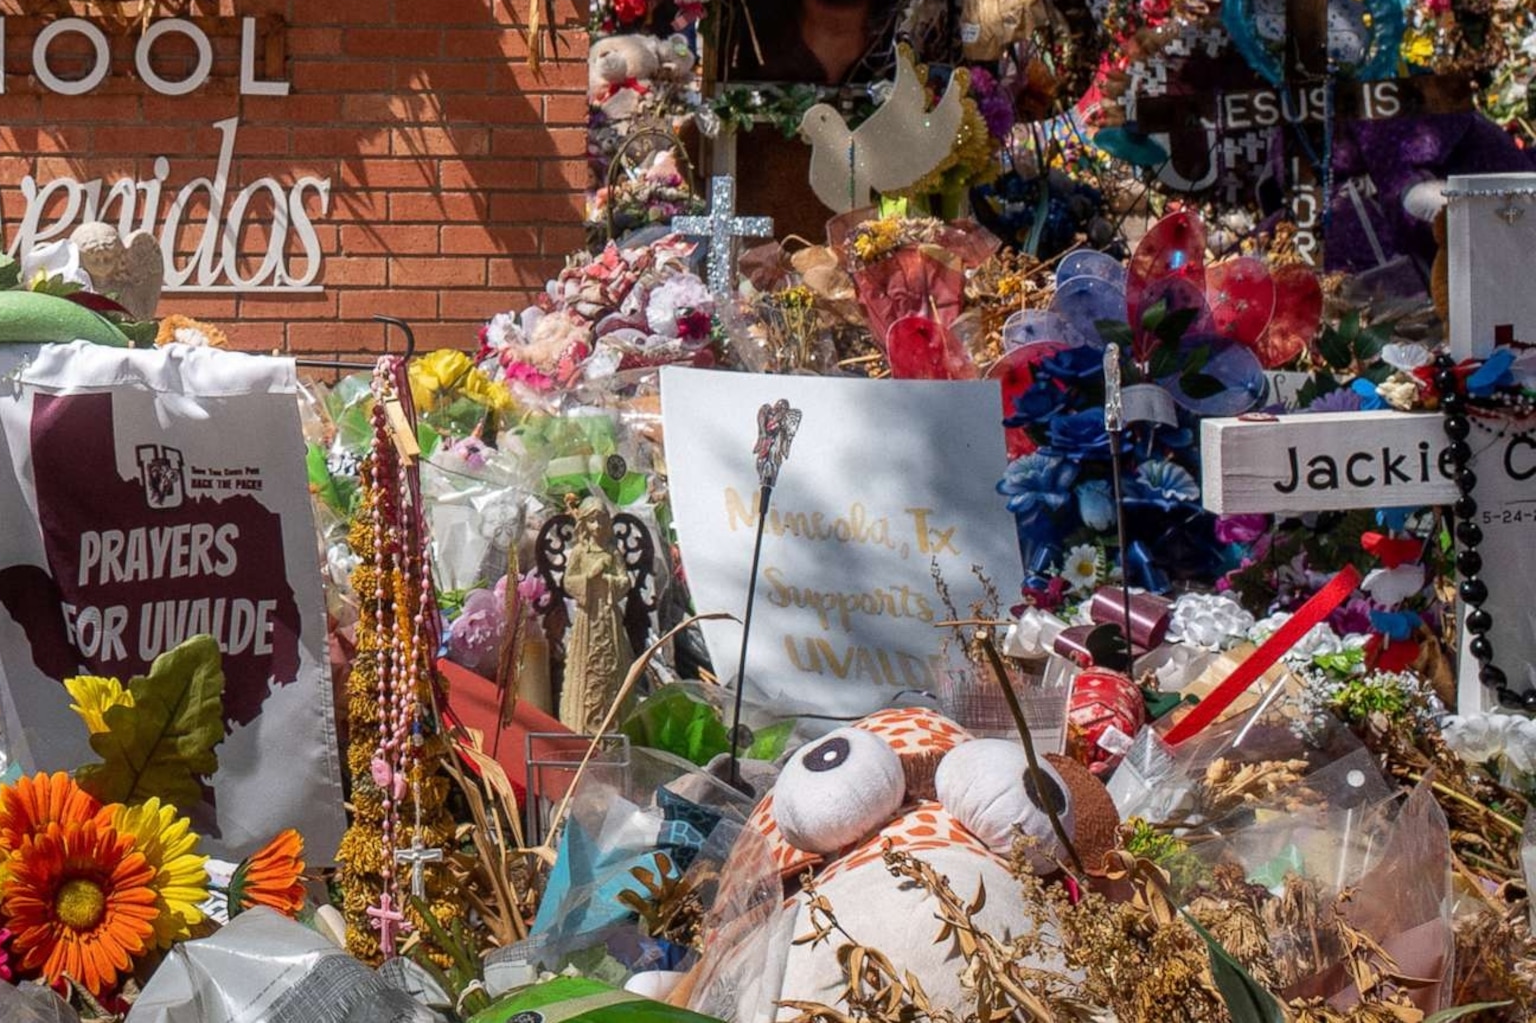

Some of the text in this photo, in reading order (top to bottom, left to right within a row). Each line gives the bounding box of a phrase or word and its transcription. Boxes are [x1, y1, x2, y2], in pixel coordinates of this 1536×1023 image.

[1200, 82, 1401, 129] JESUS IS
[216, 478, 232, 489] THE
[1273, 441, 1457, 494] Jackie
[1482, 510, 1536, 525] 5-24-
[77, 523, 240, 587] PRAYERS
[764, 566, 936, 632] Supports
[62, 598, 278, 663] FOR UVALDE
